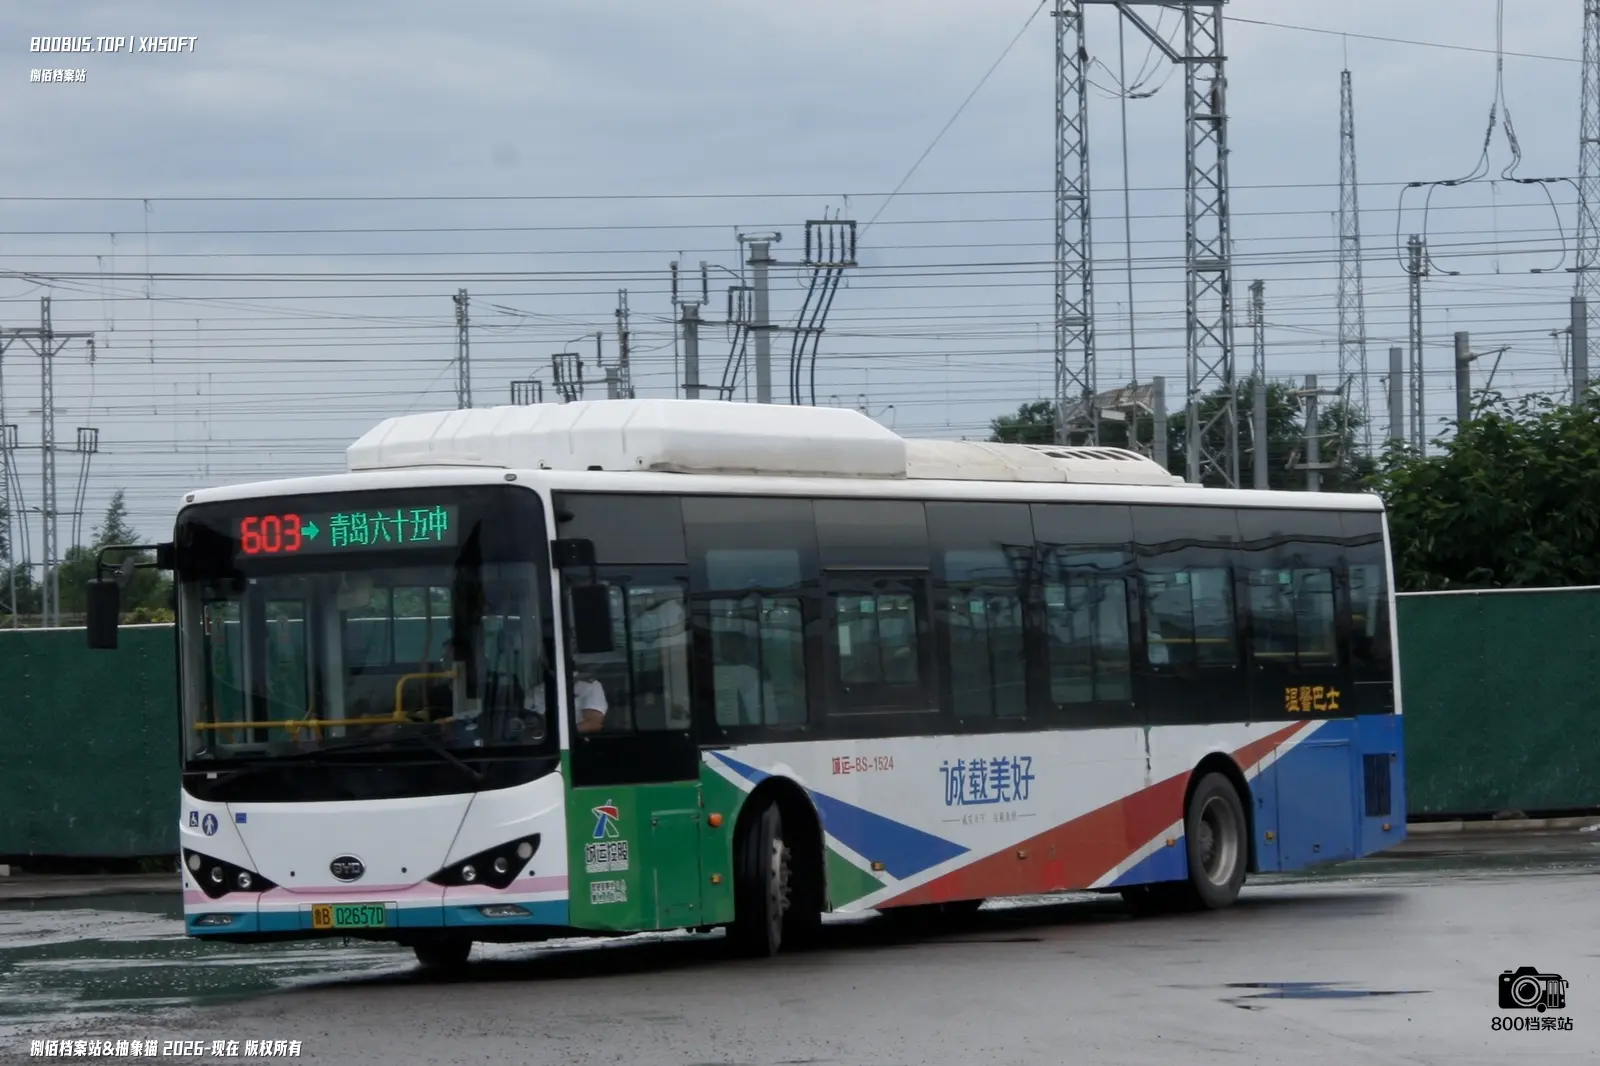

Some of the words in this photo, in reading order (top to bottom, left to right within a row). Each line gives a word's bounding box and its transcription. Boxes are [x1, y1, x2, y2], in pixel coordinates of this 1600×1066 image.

[240, 514, 301, 554] 603
[329, 505, 448, 547] 青岛六十五中
[1285, 686, 1341, 712] 温馨巴士
[939, 756, 1035, 806] 诚载美好
[585, 841, 628, 864] 城运控股
[333, 862, 360, 874] BYD
